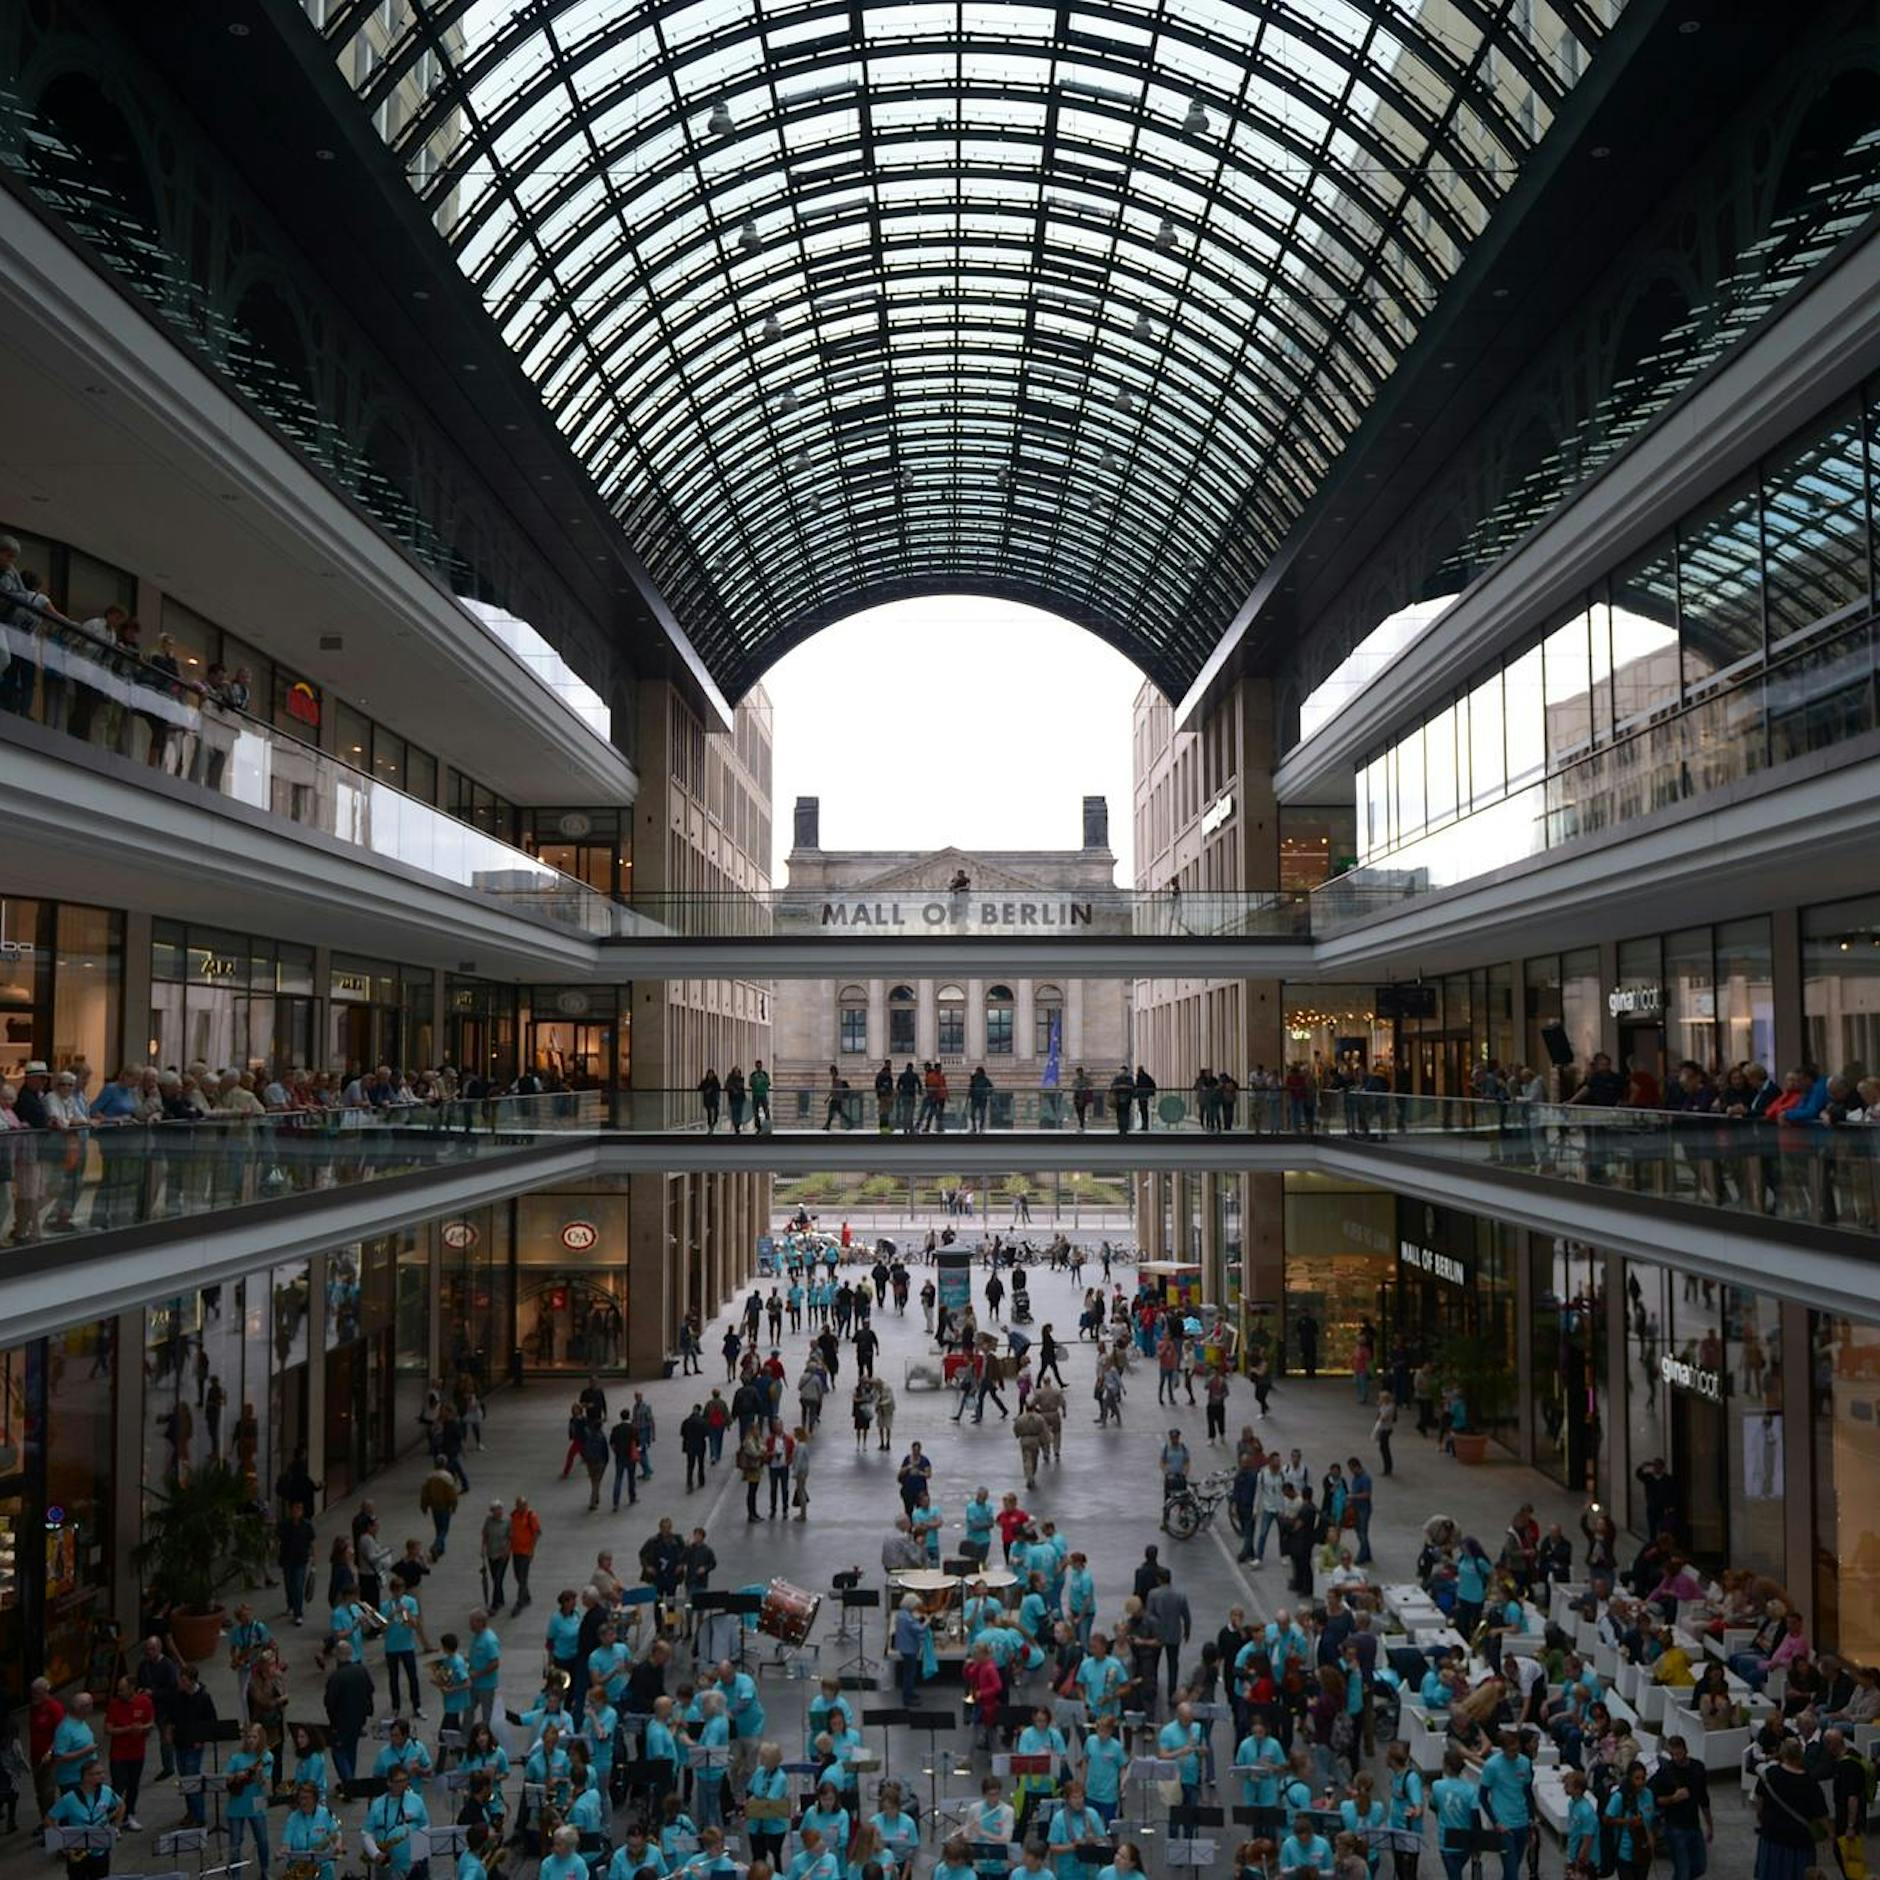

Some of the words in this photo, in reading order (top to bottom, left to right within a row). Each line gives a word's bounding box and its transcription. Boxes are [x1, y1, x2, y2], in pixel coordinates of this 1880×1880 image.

[821, 903, 905, 926] MALL
[922, 903, 965, 926] OF
[981, 903, 1092, 926] BERLIN
[1400, 1240, 1421, 1268] MALL
[1421, 1248, 1434, 1272] OF
[1434, 1253, 1465, 1286] BERLIN
